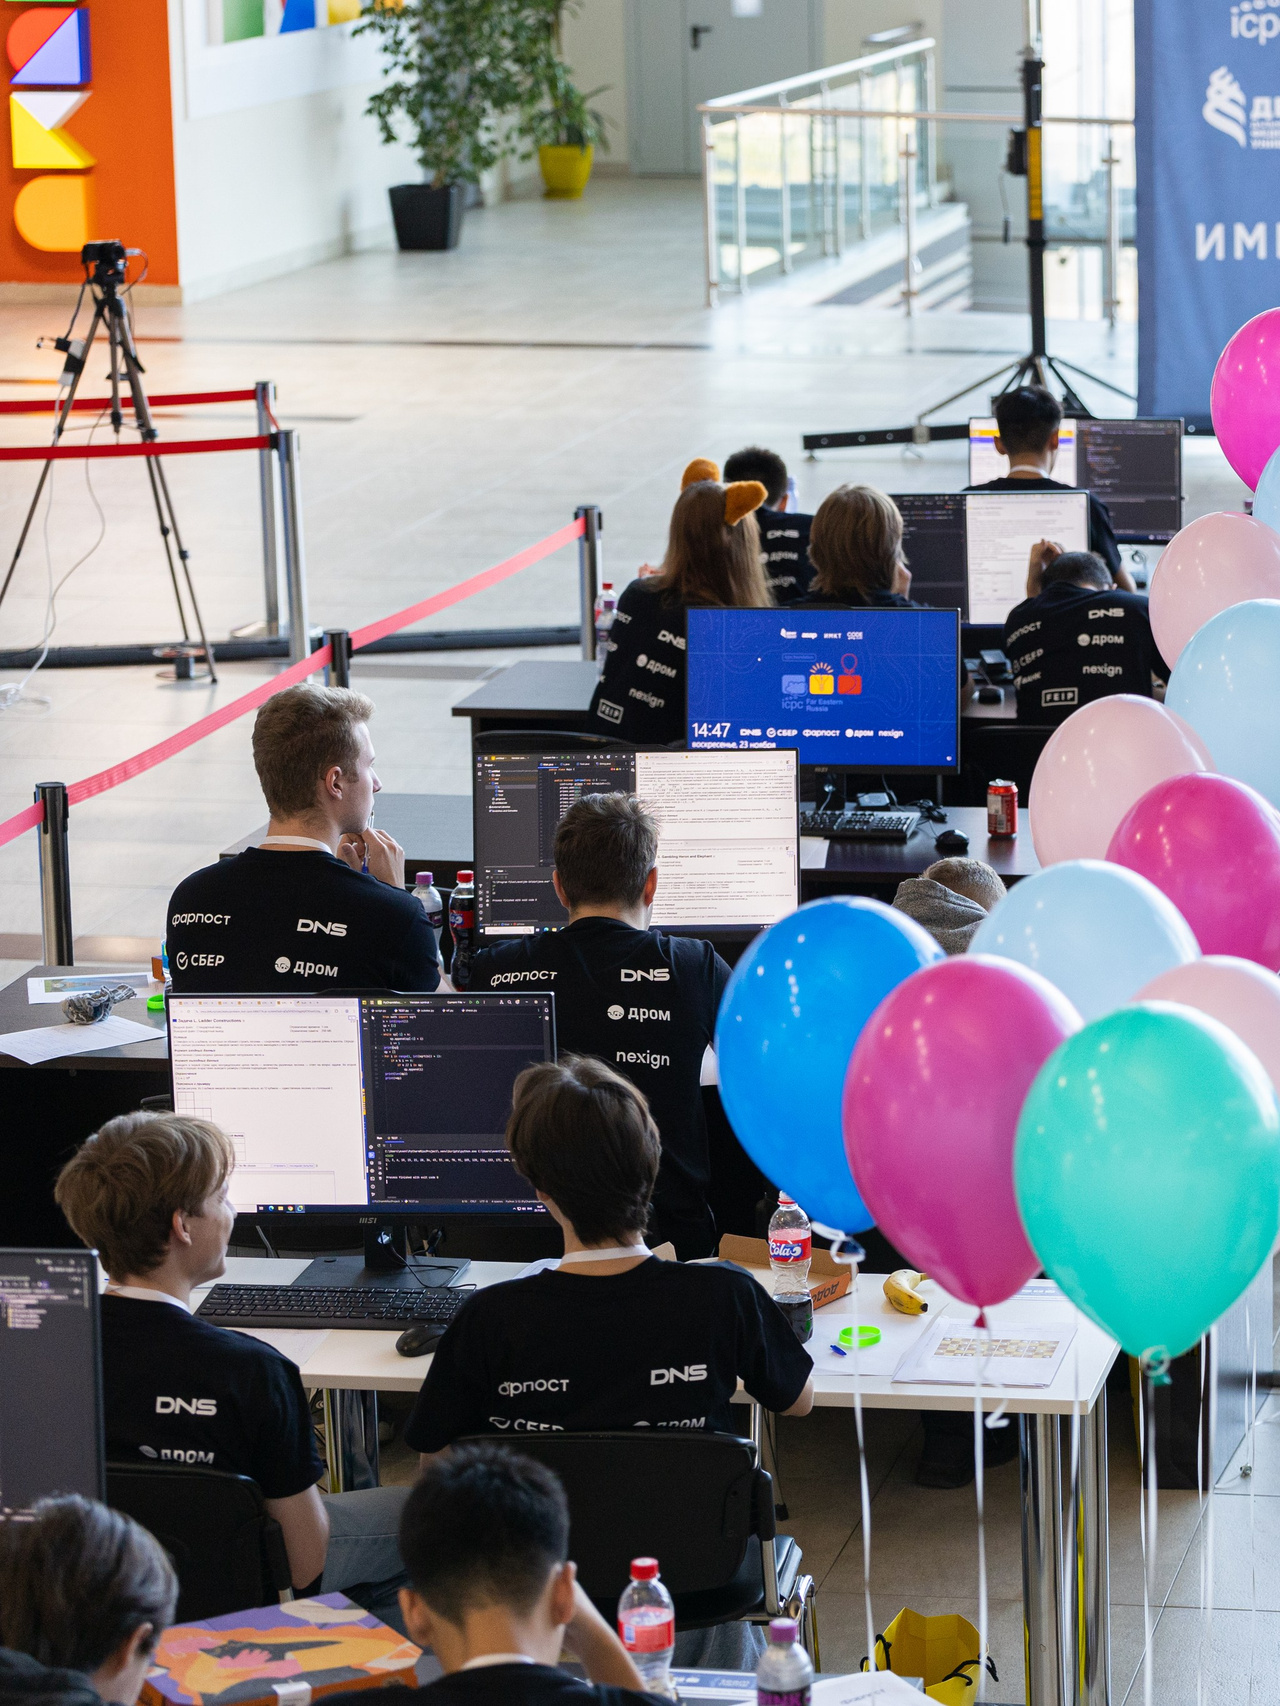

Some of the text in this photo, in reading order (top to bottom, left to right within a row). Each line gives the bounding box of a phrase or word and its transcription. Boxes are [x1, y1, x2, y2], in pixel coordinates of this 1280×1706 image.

[767, 529, 799, 539] DNS
[1088, 608, 1125, 619] DNS
[657, 629, 687, 650] DNS
[1091, 635, 1125, 647] дром
[646, 659, 677, 679] дром
[1082, 663, 1122, 678] nexign
[628, 688, 665, 708] nexign
[782, 698, 804, 711] icpc
[1046, 692, 1074, 702] FEIP
[692, 722, 731, 738] 14:47
[777, 729, 798, 737] СБЕР
[853, 729, 874, 738] дром
[878, 729, 904, 739] nexign
[691, 740, 776, 749] воскресенье, 23 ноября
[171, 912, 231, 928] фарпост
[296, 918, 348, 937] DNS
[191, 953, 225, 967] СБЕР
[293, 960, 339, 978] дром
[620, 968, 670, 982] DNS
[490, 970, 558, 988] фарпост
[627, 1006, 671, 1022] дром
[616, 1050, 670, 1070] nexign
[769, 1241, 791, 1257] Cola
[650, 1364, 708, 1386] DNS
[155, 1396, 217, 1416] DNS
